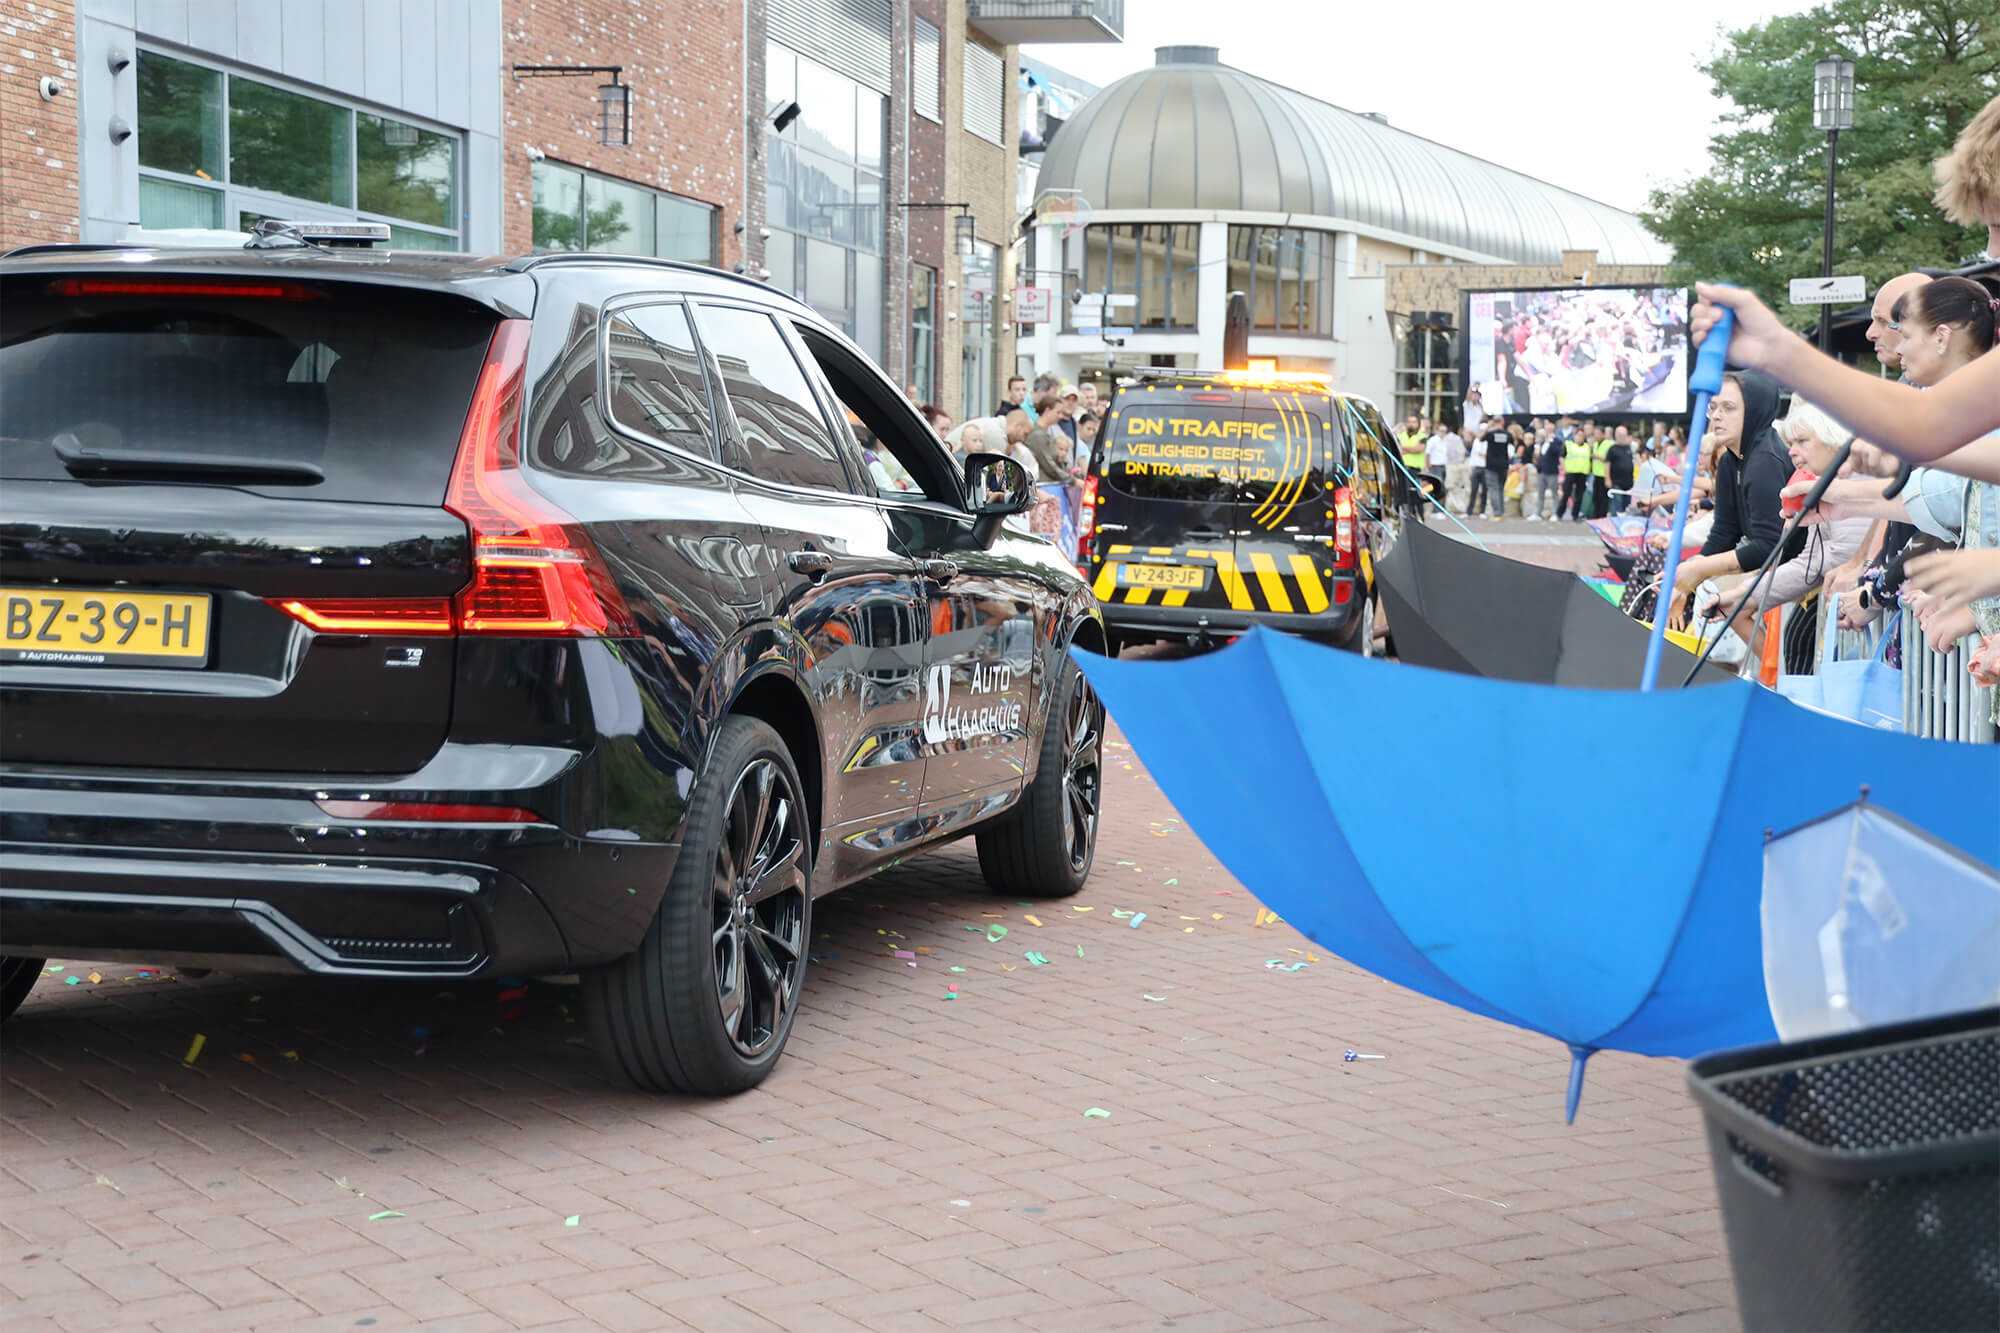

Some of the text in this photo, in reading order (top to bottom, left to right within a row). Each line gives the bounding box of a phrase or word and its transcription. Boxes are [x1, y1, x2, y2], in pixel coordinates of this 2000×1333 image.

[1127, 418, 1277, 440] DN TRAFFIC
[1127, 443, 1209, 458] VEILIGHEID
[1125, 461, 1149, 475] DN
[1151, 463, 1215, 479] TRAFFIC
[1132, 567, 1197, 584] V-243-JF
